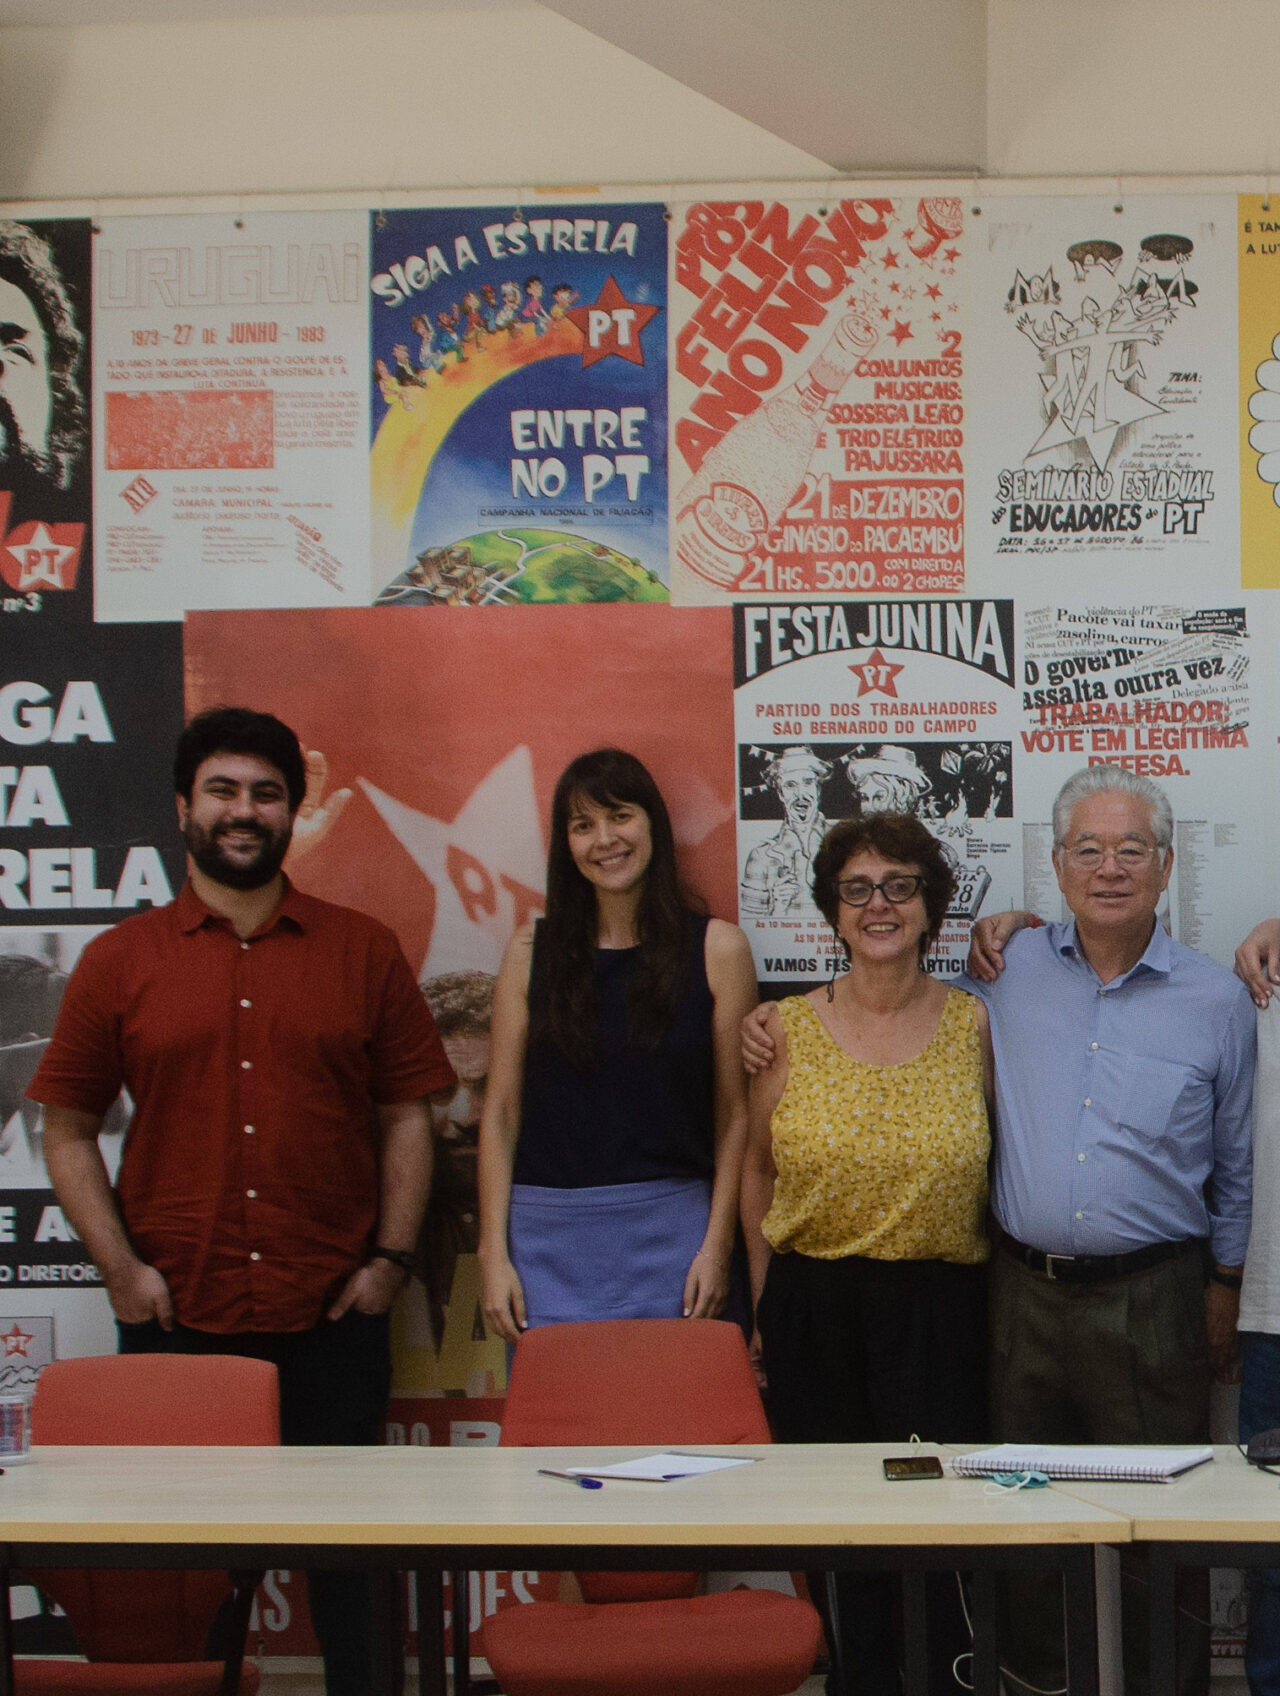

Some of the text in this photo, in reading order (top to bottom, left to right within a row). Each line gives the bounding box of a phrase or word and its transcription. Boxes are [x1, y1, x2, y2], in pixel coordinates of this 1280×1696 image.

[1244, 219, 1252, 232] É
[1246, 243, 1256, 255] A
[370, 219, 638, 307] SIGA A ESTRELA
[753, 198, 895, 354] NOVO
[676, 201, 821, 389] FELIZ
[227, 321, 279, 344] JUNHO
[588, 308, 636, 348] PT
[941, 330, 962, 358] 2
[855, 358, 963, 378] CONJUNTOS
[826, 403, 909, 425] SOSSEGA
[511, 407, 646, 452] ENTRE
[837, 426, 963, 449] TRIO ELÉTRICO
[845, 449, 963, 474] PAJUSSARA
[511, 454, 649, 504] NO PT
[996, 464, 1214, 502] SEMINÁRIO ESTADUAL
[786, 473, 963, 520] 21 DEZEMBRO
[1010, 500, 1205, 534] EDUCADORES PT
[24, 549, 60, 576] PT
[739, 556, 774, 591] 21
[884, 559, 908, 571] COM
[1057, 609, 1109, 626] Pacote
[1113, 615, 1135, 627] vai
[1140, 617, 1182, 630] taxar
[744, 606, 851, 677] FESTA
[856, 602, 1009, 680] JUNINA
[862, 663, 891, 687] PT
[1023, 657, 1225, 711] assalta outra vez
[1024, 661, 1040, 685] O
[1172, 686, 1219, 699] Delegado
[756, 701, 997, 718] PARTIDO DOS TRABALHADORES
[773, 717, 977, 735] SÃO BERNARDO DO CAMPO
[1021, 723, 1249, 752] VOTE EM LEGÍTIMA
[764, 958, 817, 972] VAMOS
